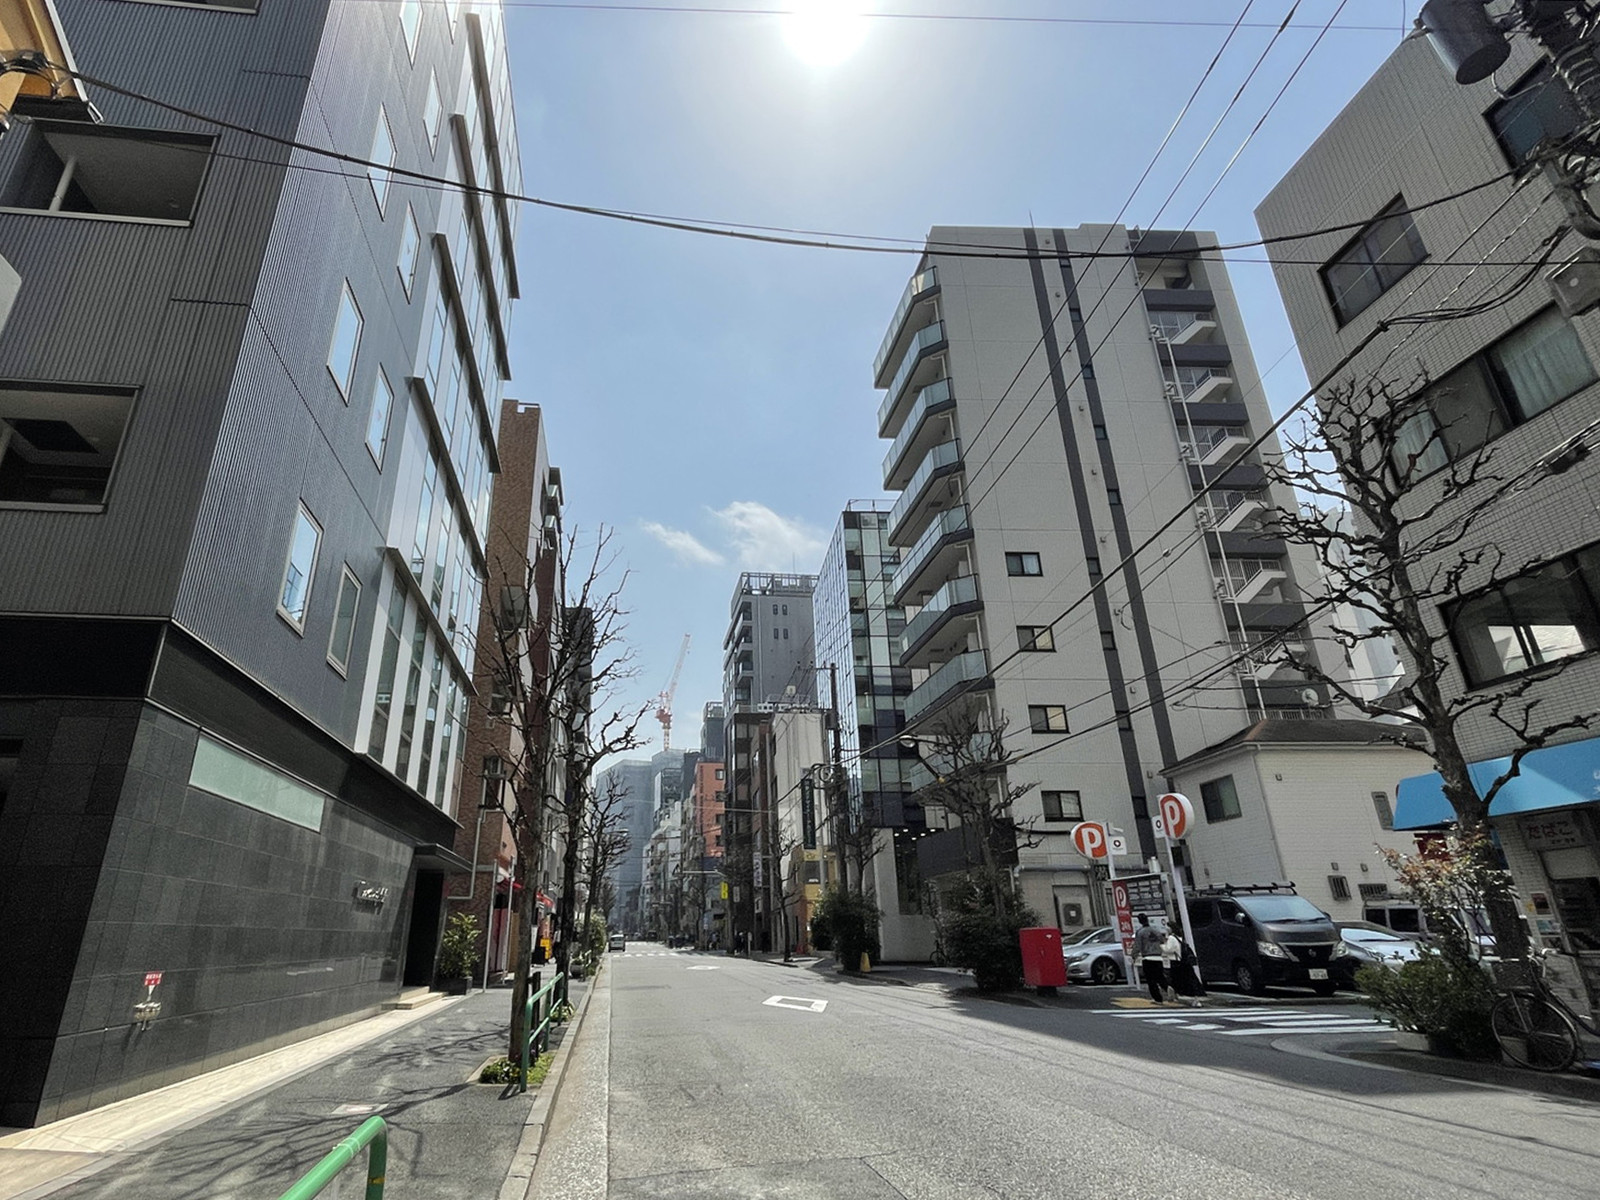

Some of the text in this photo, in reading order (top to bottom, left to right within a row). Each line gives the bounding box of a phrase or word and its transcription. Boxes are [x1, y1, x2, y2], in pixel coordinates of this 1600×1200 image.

[1164, 801, 1180, 838] P
[1527, 820, 1574, 839] たばこ
[1081, 827, 1102, 859] P
